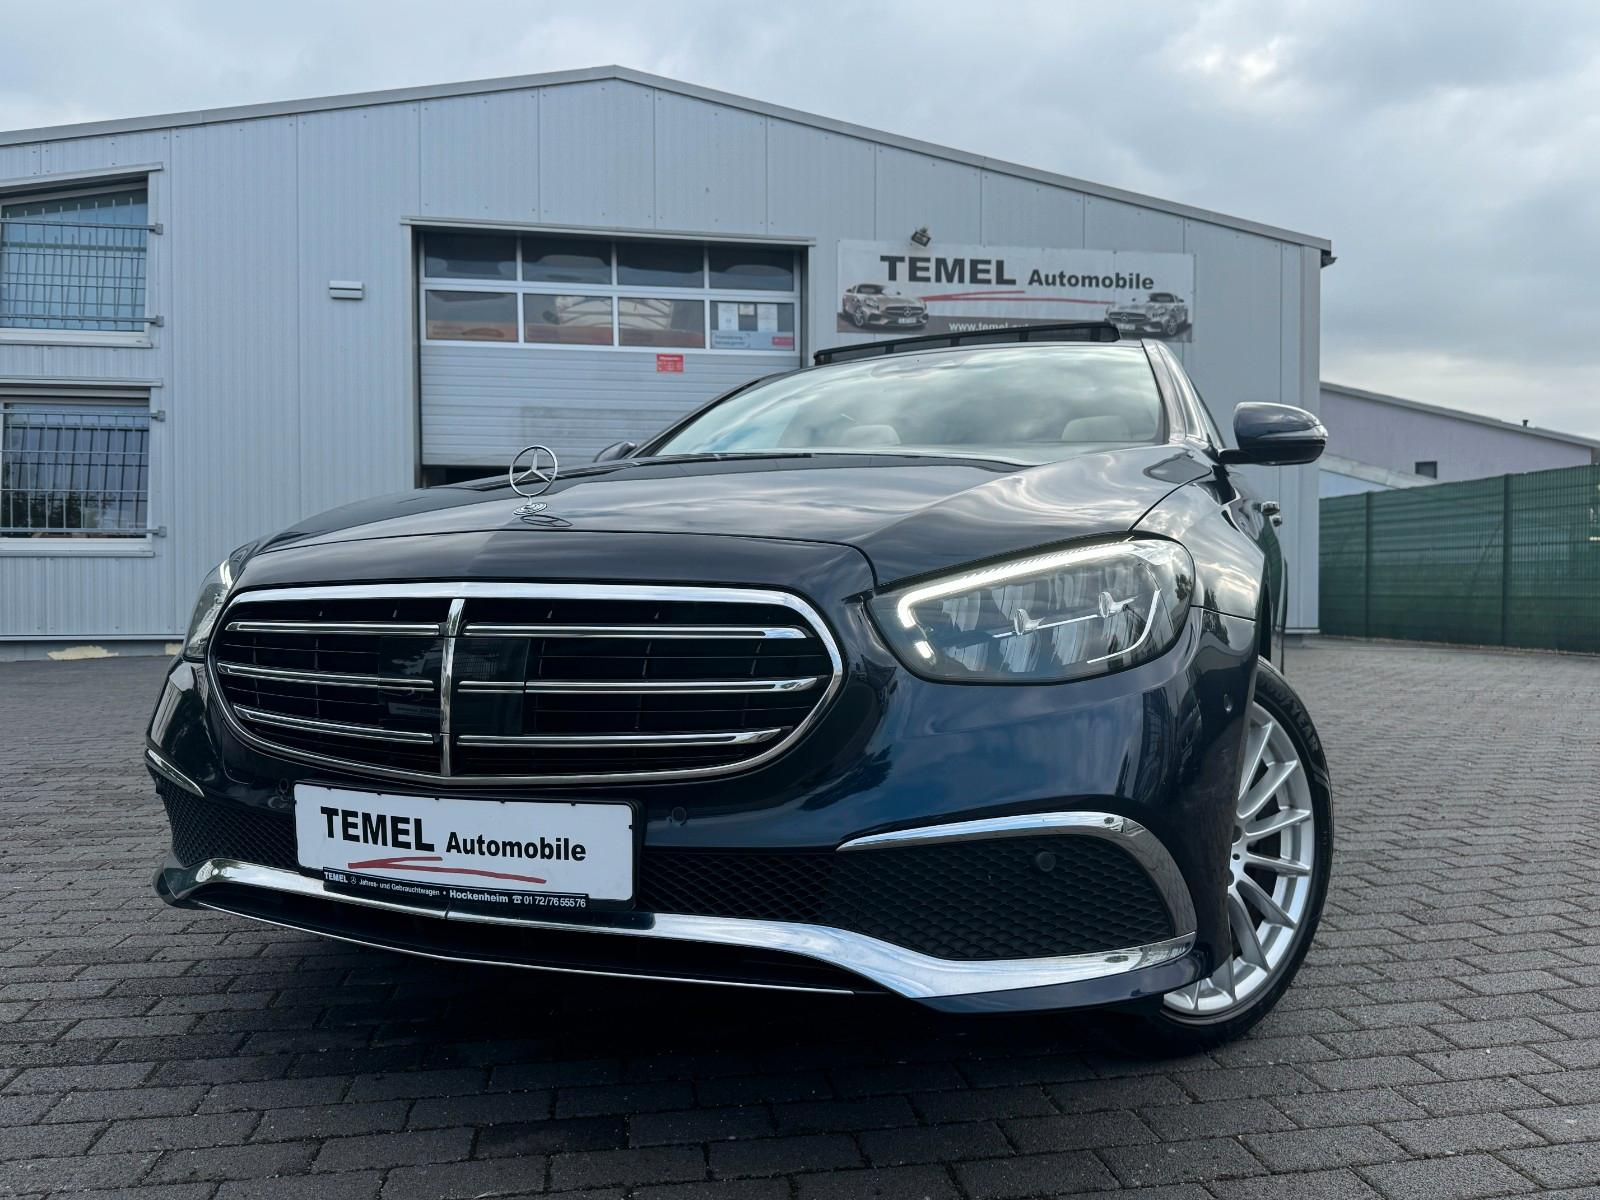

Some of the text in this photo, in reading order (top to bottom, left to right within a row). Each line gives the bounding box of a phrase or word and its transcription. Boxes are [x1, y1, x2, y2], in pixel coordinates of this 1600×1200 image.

[880, 255, 1154, 290] TEMEL Automobile
[948, 321, 1030, 331] www.temel
[320, 806, 587, 861] TEMEL Automobile
[324, 871, 348, 883] TEMEL
[359, 879, 379, 888] Jahres-
[391, 883, 441, 897] Gebrauchtwagen
[449, 889, 508, 903] Hockenheim
